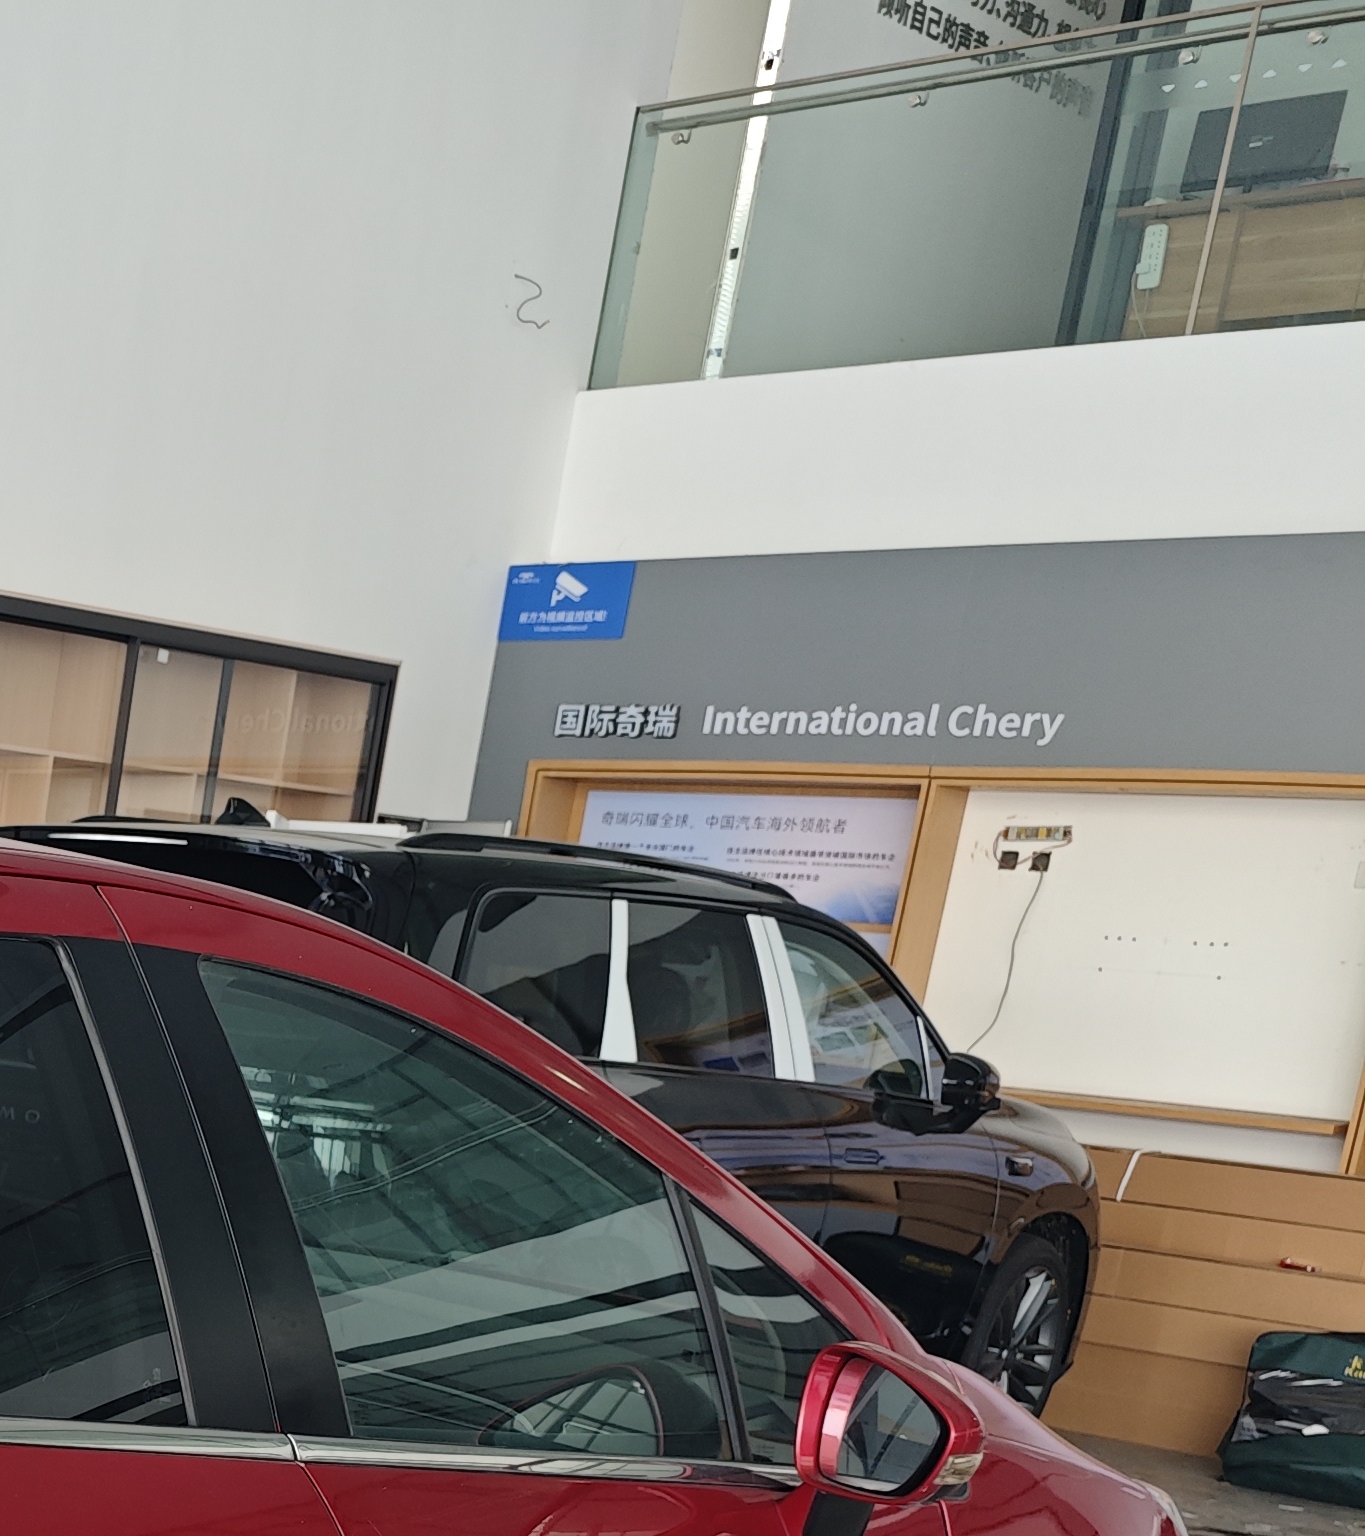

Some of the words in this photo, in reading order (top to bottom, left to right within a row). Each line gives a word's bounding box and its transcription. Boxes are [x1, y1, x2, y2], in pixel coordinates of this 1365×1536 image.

[553, 703, 680, 739] 国际奇瑞
[702, 703, 939, 738] International
[947, 703, 1065, 746] Chery
